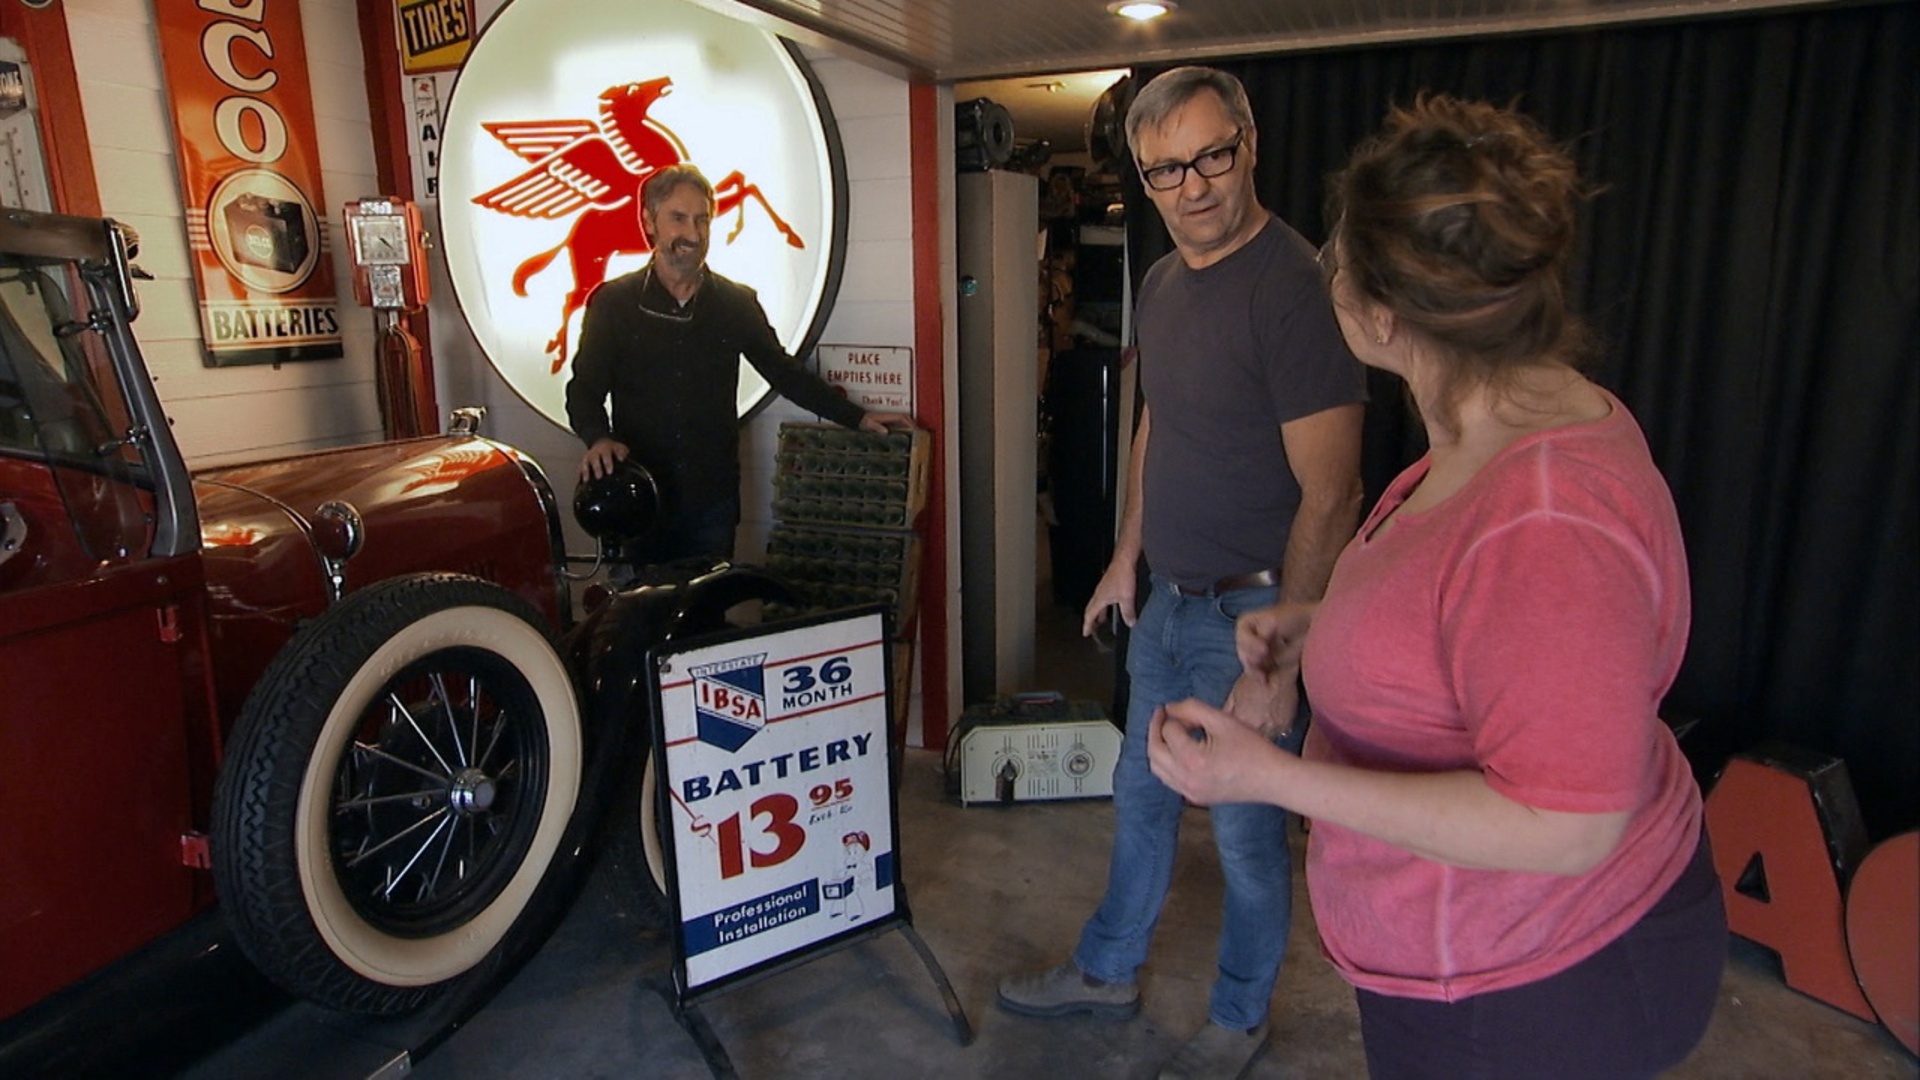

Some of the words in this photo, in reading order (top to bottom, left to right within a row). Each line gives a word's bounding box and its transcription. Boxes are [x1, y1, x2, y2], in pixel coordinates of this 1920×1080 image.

[404, 0, 467, 51] TIRES
[213, 307, 338, 340] BATTERIES
[828, 370, 872, 384] EMPTIES
[875, 372, 902, 385] HERE
[848, 353, 880, 365] PLACE
[783, 656, 852, 693] 36
[702, 682, 761, 719] IBSA
[783, 682, 852, 709] MONTH
[683, 732, 872, 803] BATTERY
[809, 777, 853, 806] 95
[714, 885, 807, 927] Professional
[719, 906, 806, 943] Installation
